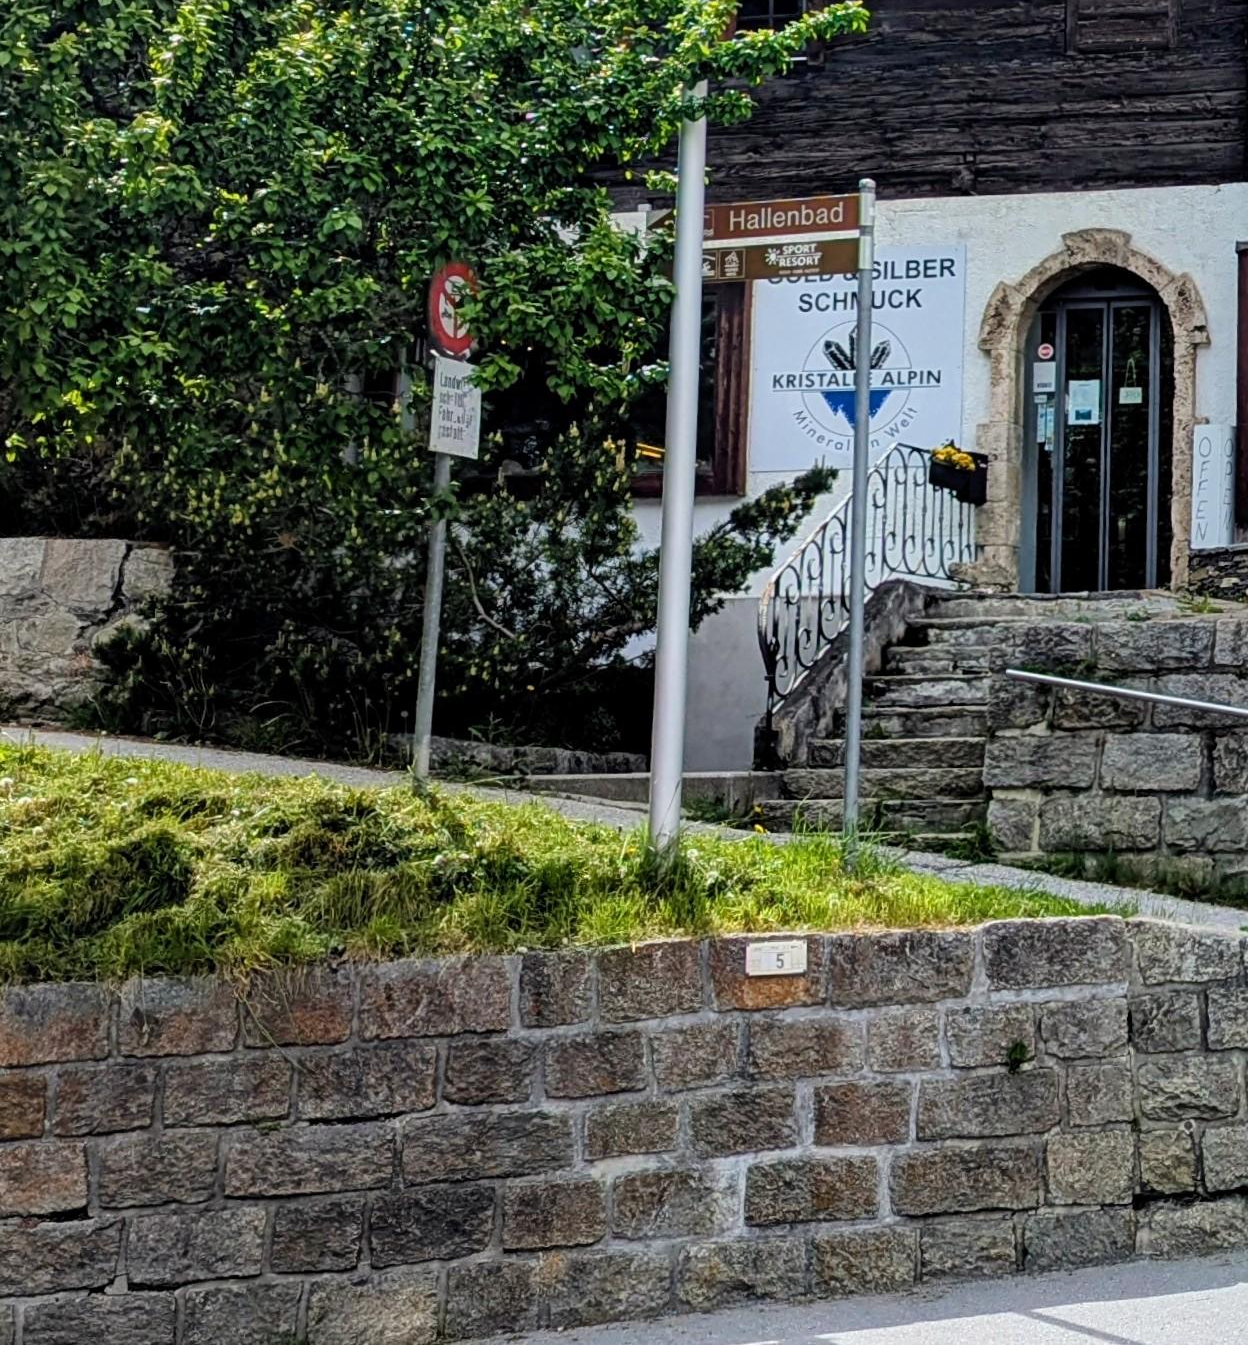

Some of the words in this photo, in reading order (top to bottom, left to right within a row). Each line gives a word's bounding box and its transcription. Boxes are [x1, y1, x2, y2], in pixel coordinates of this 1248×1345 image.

[729, 202, 844, 231] Hallenbad
[782, 243, 818, 255] SPORT
[779, 255, 821, 267] RESORT
[881, 370, 941, 385] ALPIN
[884, 406, 918, 438] Welt
[1195, 436, 1212, 541] OFFEN
[776, 954, 784, 969] 5
